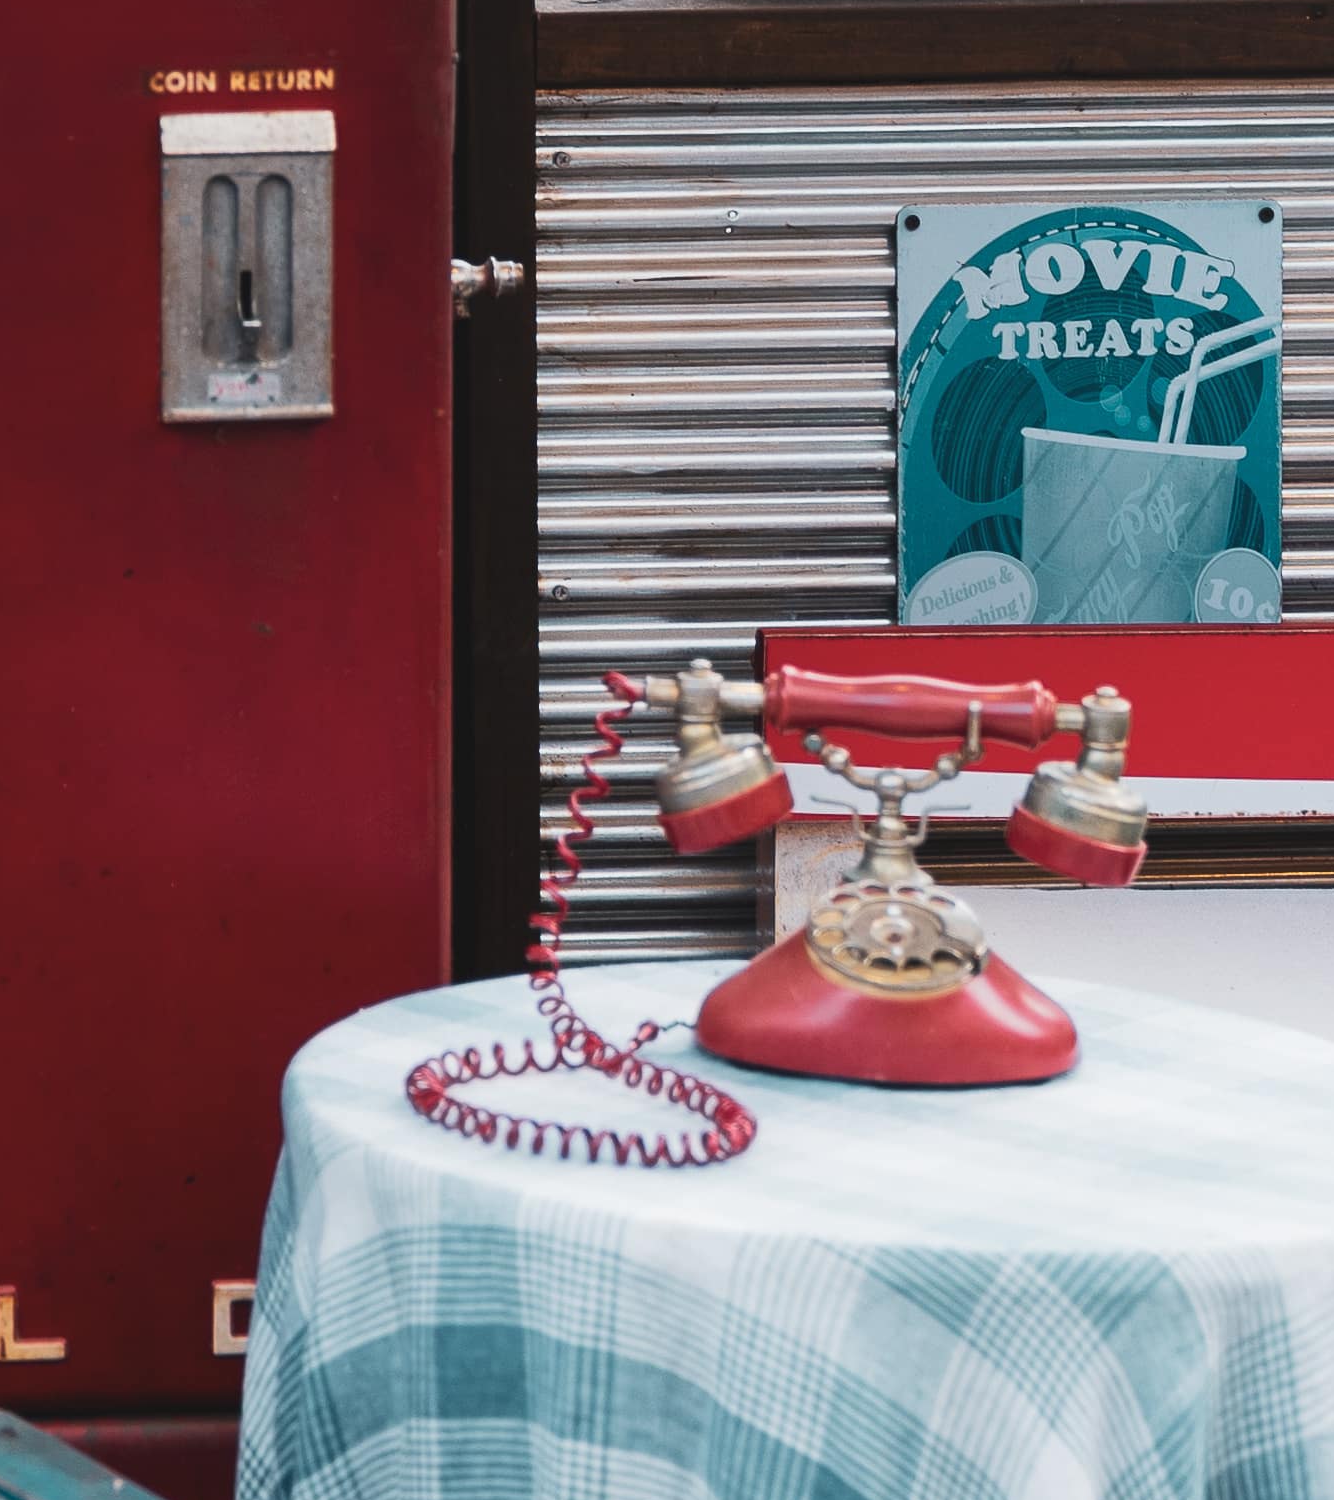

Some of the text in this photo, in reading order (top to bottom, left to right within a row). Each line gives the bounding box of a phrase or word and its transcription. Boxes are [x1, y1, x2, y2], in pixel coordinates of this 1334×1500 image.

[149, 68, 336, 95] COIN RETURN
[953, 238, 1235, 320] MOVIE
[992, 317, 1195, 361] TREATS
[918, 565, 1014, 617] Delicious &
